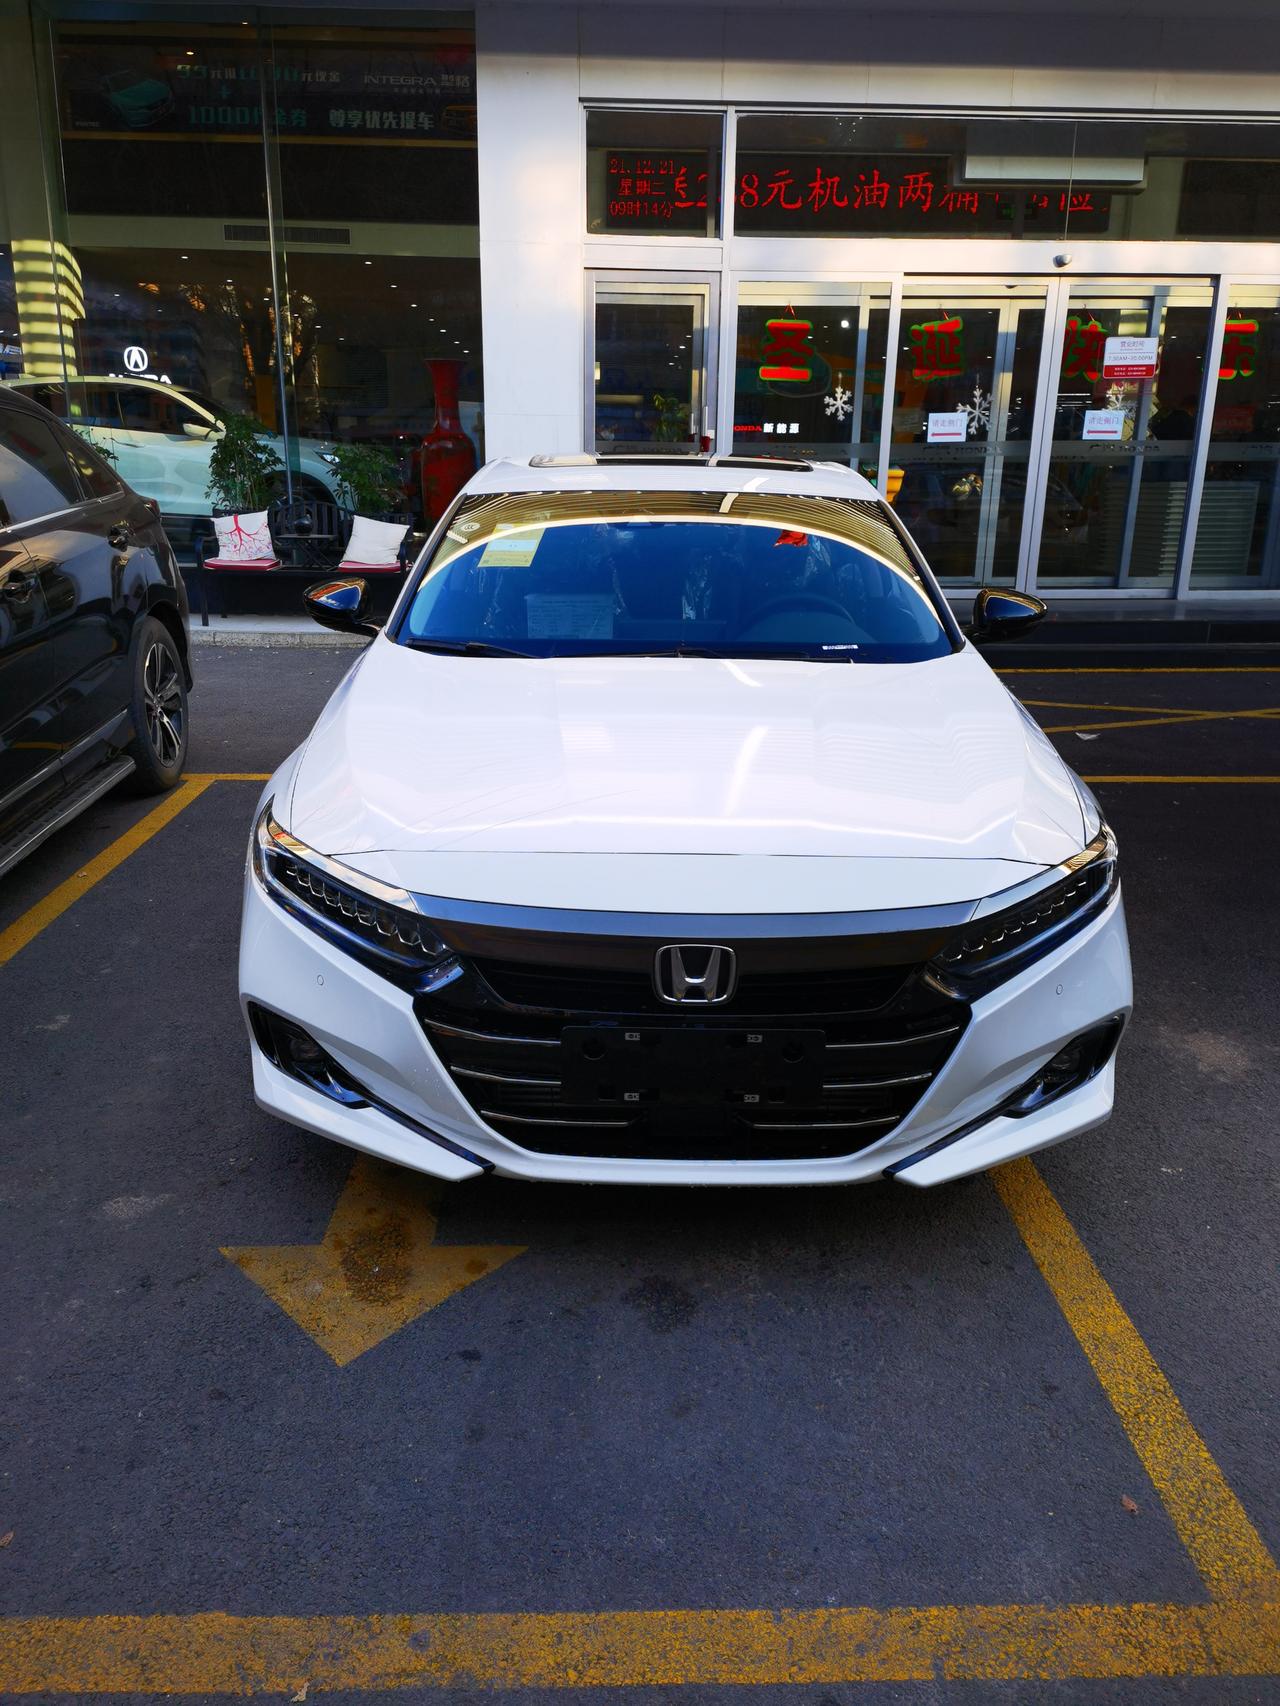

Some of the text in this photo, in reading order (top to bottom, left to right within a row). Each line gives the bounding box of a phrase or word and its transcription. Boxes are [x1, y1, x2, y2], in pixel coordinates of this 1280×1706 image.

[363, 74, 471, 89] INTEGRA 型格
[328, 109, 434, 130] 尊享优先提车
[609, 158, 675, 175] 21.12.21
[618, 178, 666, 196] 星期二
[609, 201, 673, 218] 09时14分
[763, 422, 800, 434] 新能源
